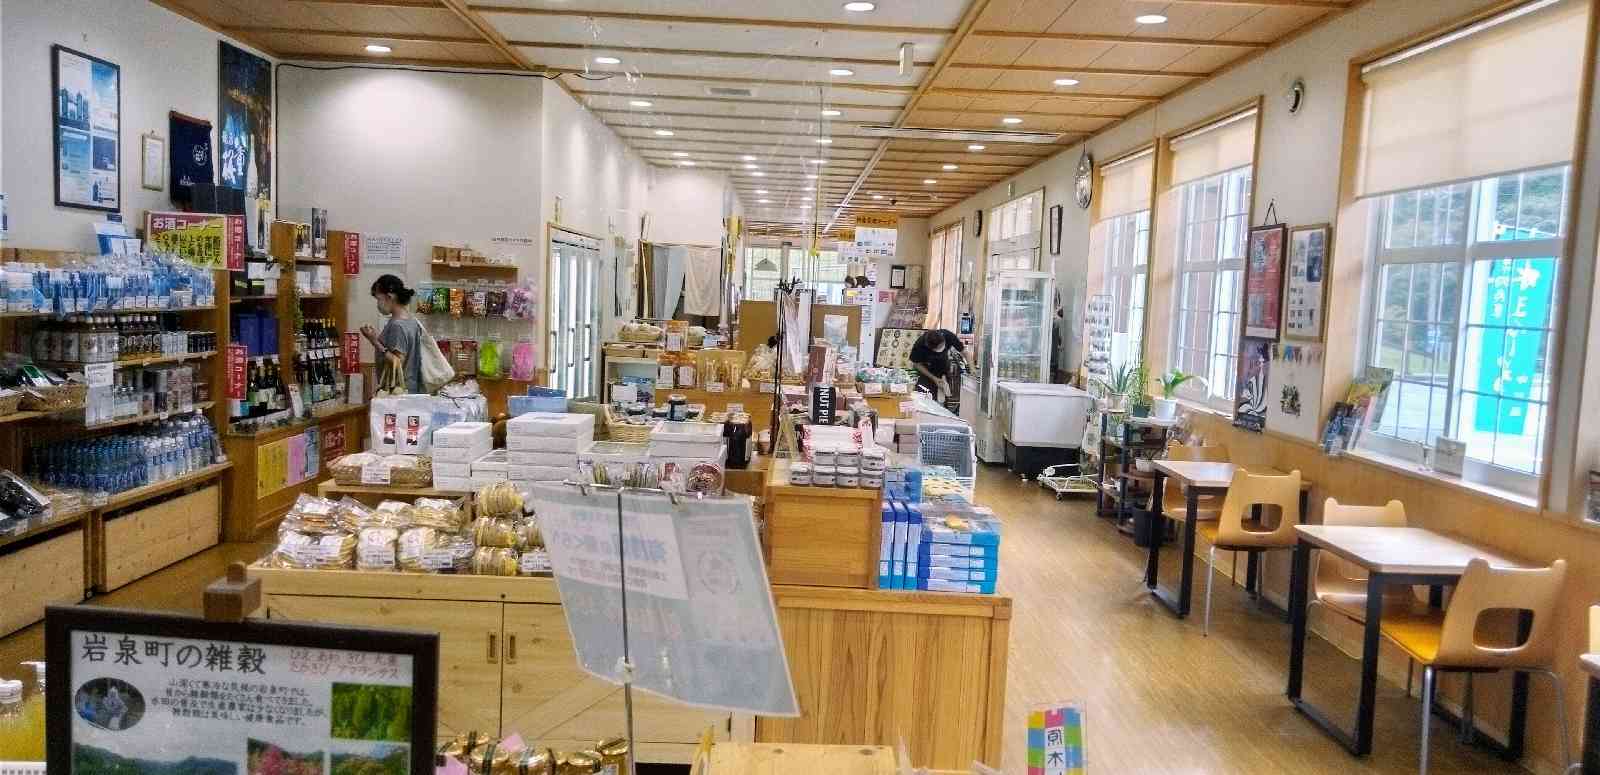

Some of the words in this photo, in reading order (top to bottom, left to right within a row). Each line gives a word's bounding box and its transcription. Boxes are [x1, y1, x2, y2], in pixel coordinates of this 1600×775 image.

[153, 217, 221, 231] お酒コーナー
[234, 218, 242, 267] お酒コーナー
[233, 348, 242, 399] お酒コーナー
[819, 410, 829, 424] PIE
[81, 634, 267, 675] 岩泉町の雑穀
